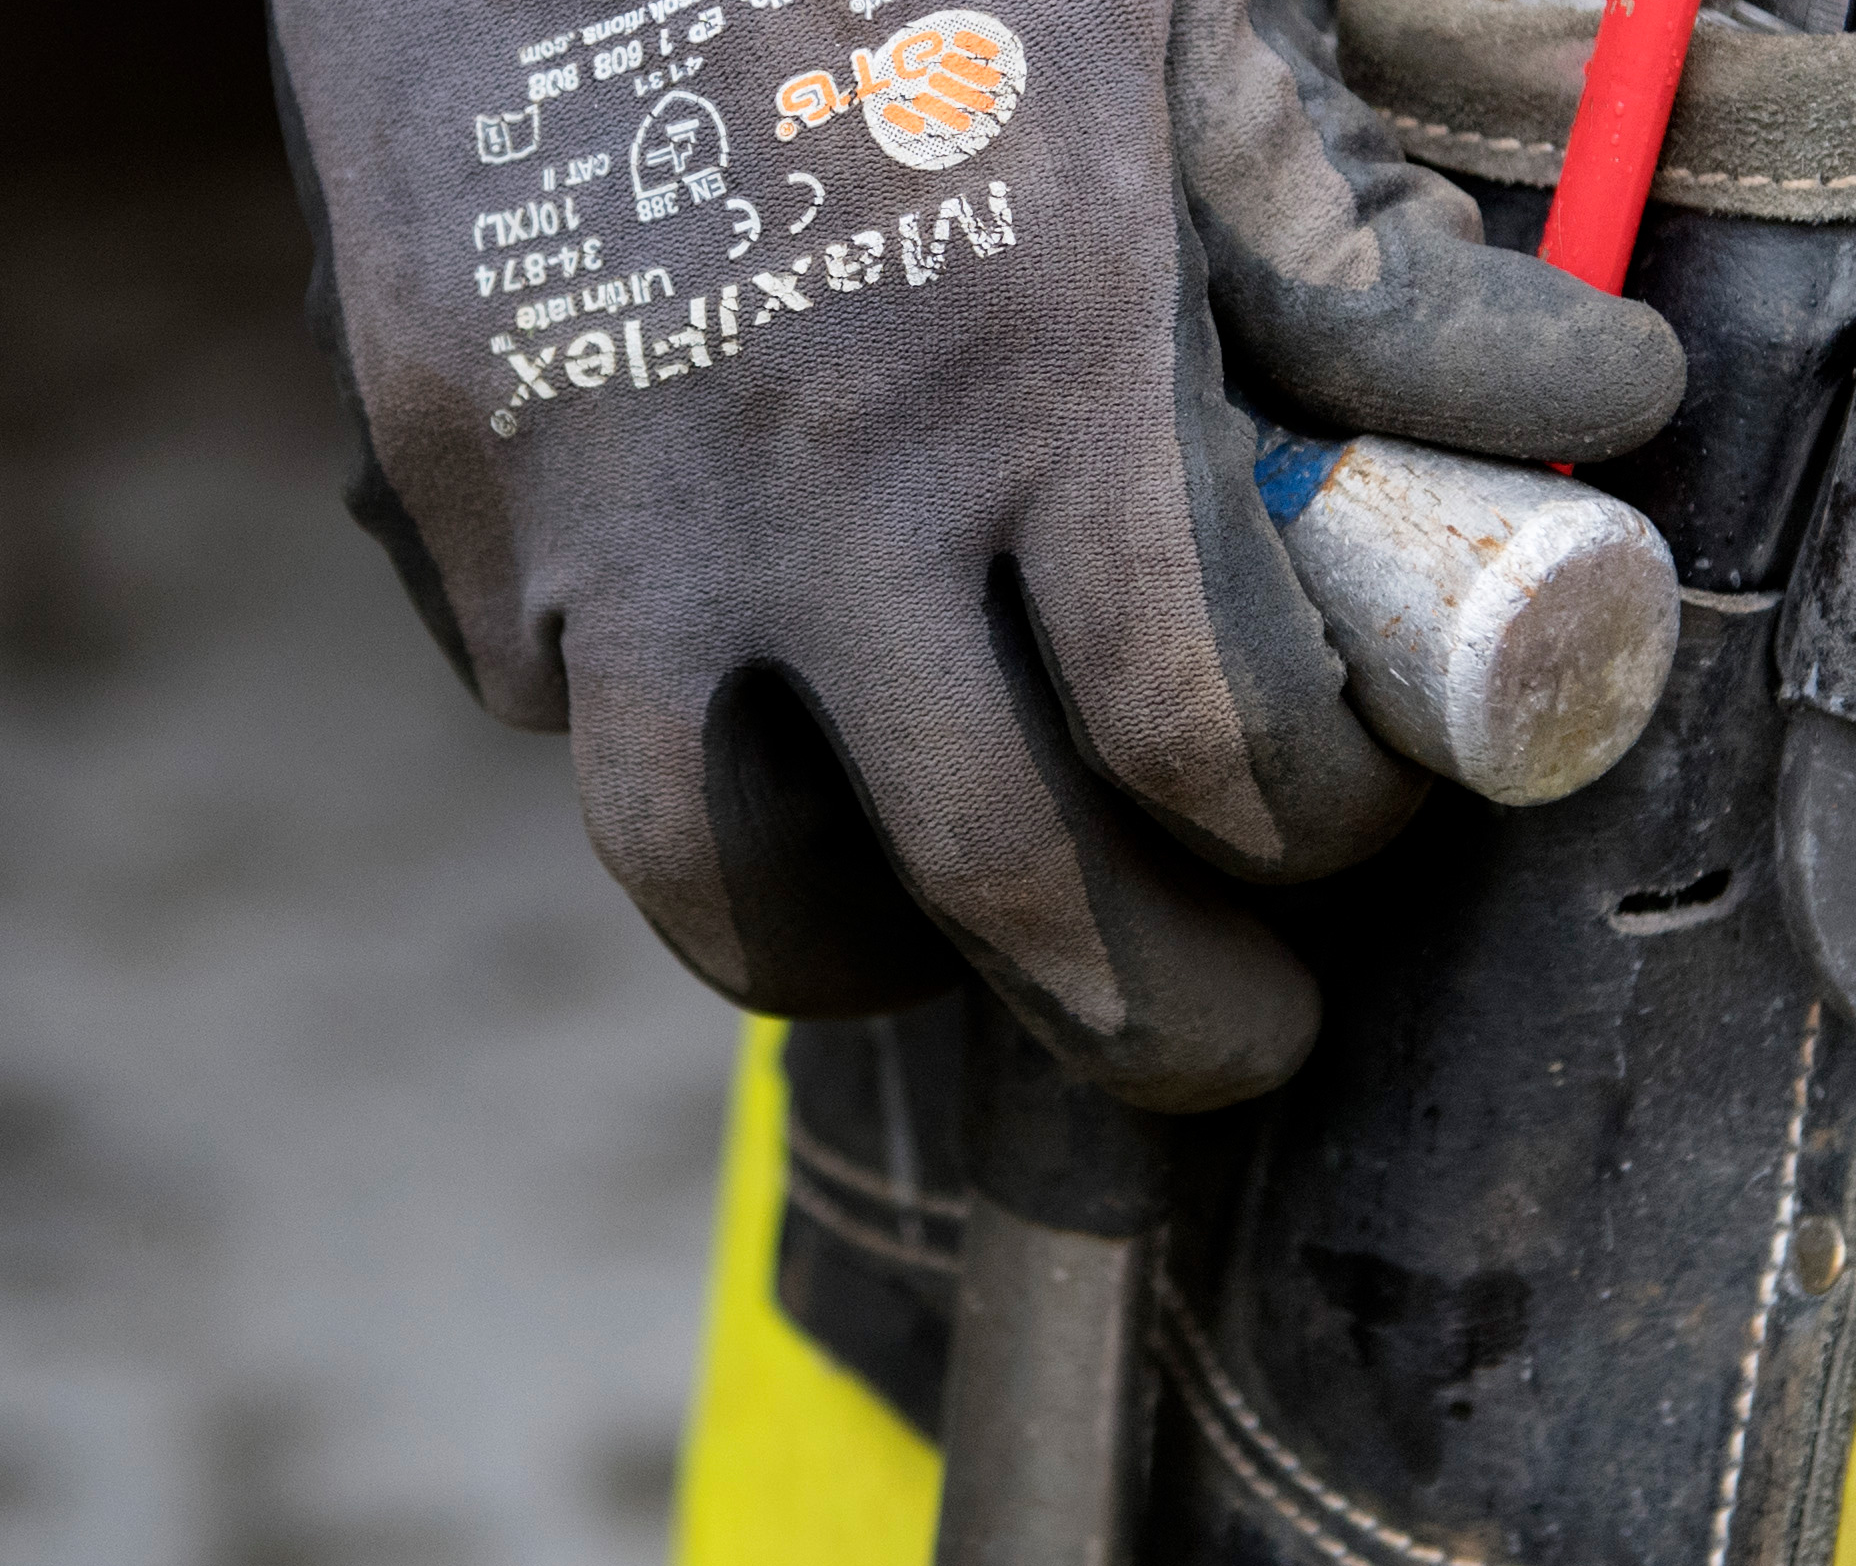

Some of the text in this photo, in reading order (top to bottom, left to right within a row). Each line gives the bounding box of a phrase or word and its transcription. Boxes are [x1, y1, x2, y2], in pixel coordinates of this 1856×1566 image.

[659, 28, 673, 57] 1
[688, 6, 727, 44] EP
[594, 39, 644, 81] 608
[528, 63, 580, 102] 808
[565, 153, 610, 185] CAT
[636, 171, 728, 222] EN 388
[474, 238, 603, 297] 34-874
